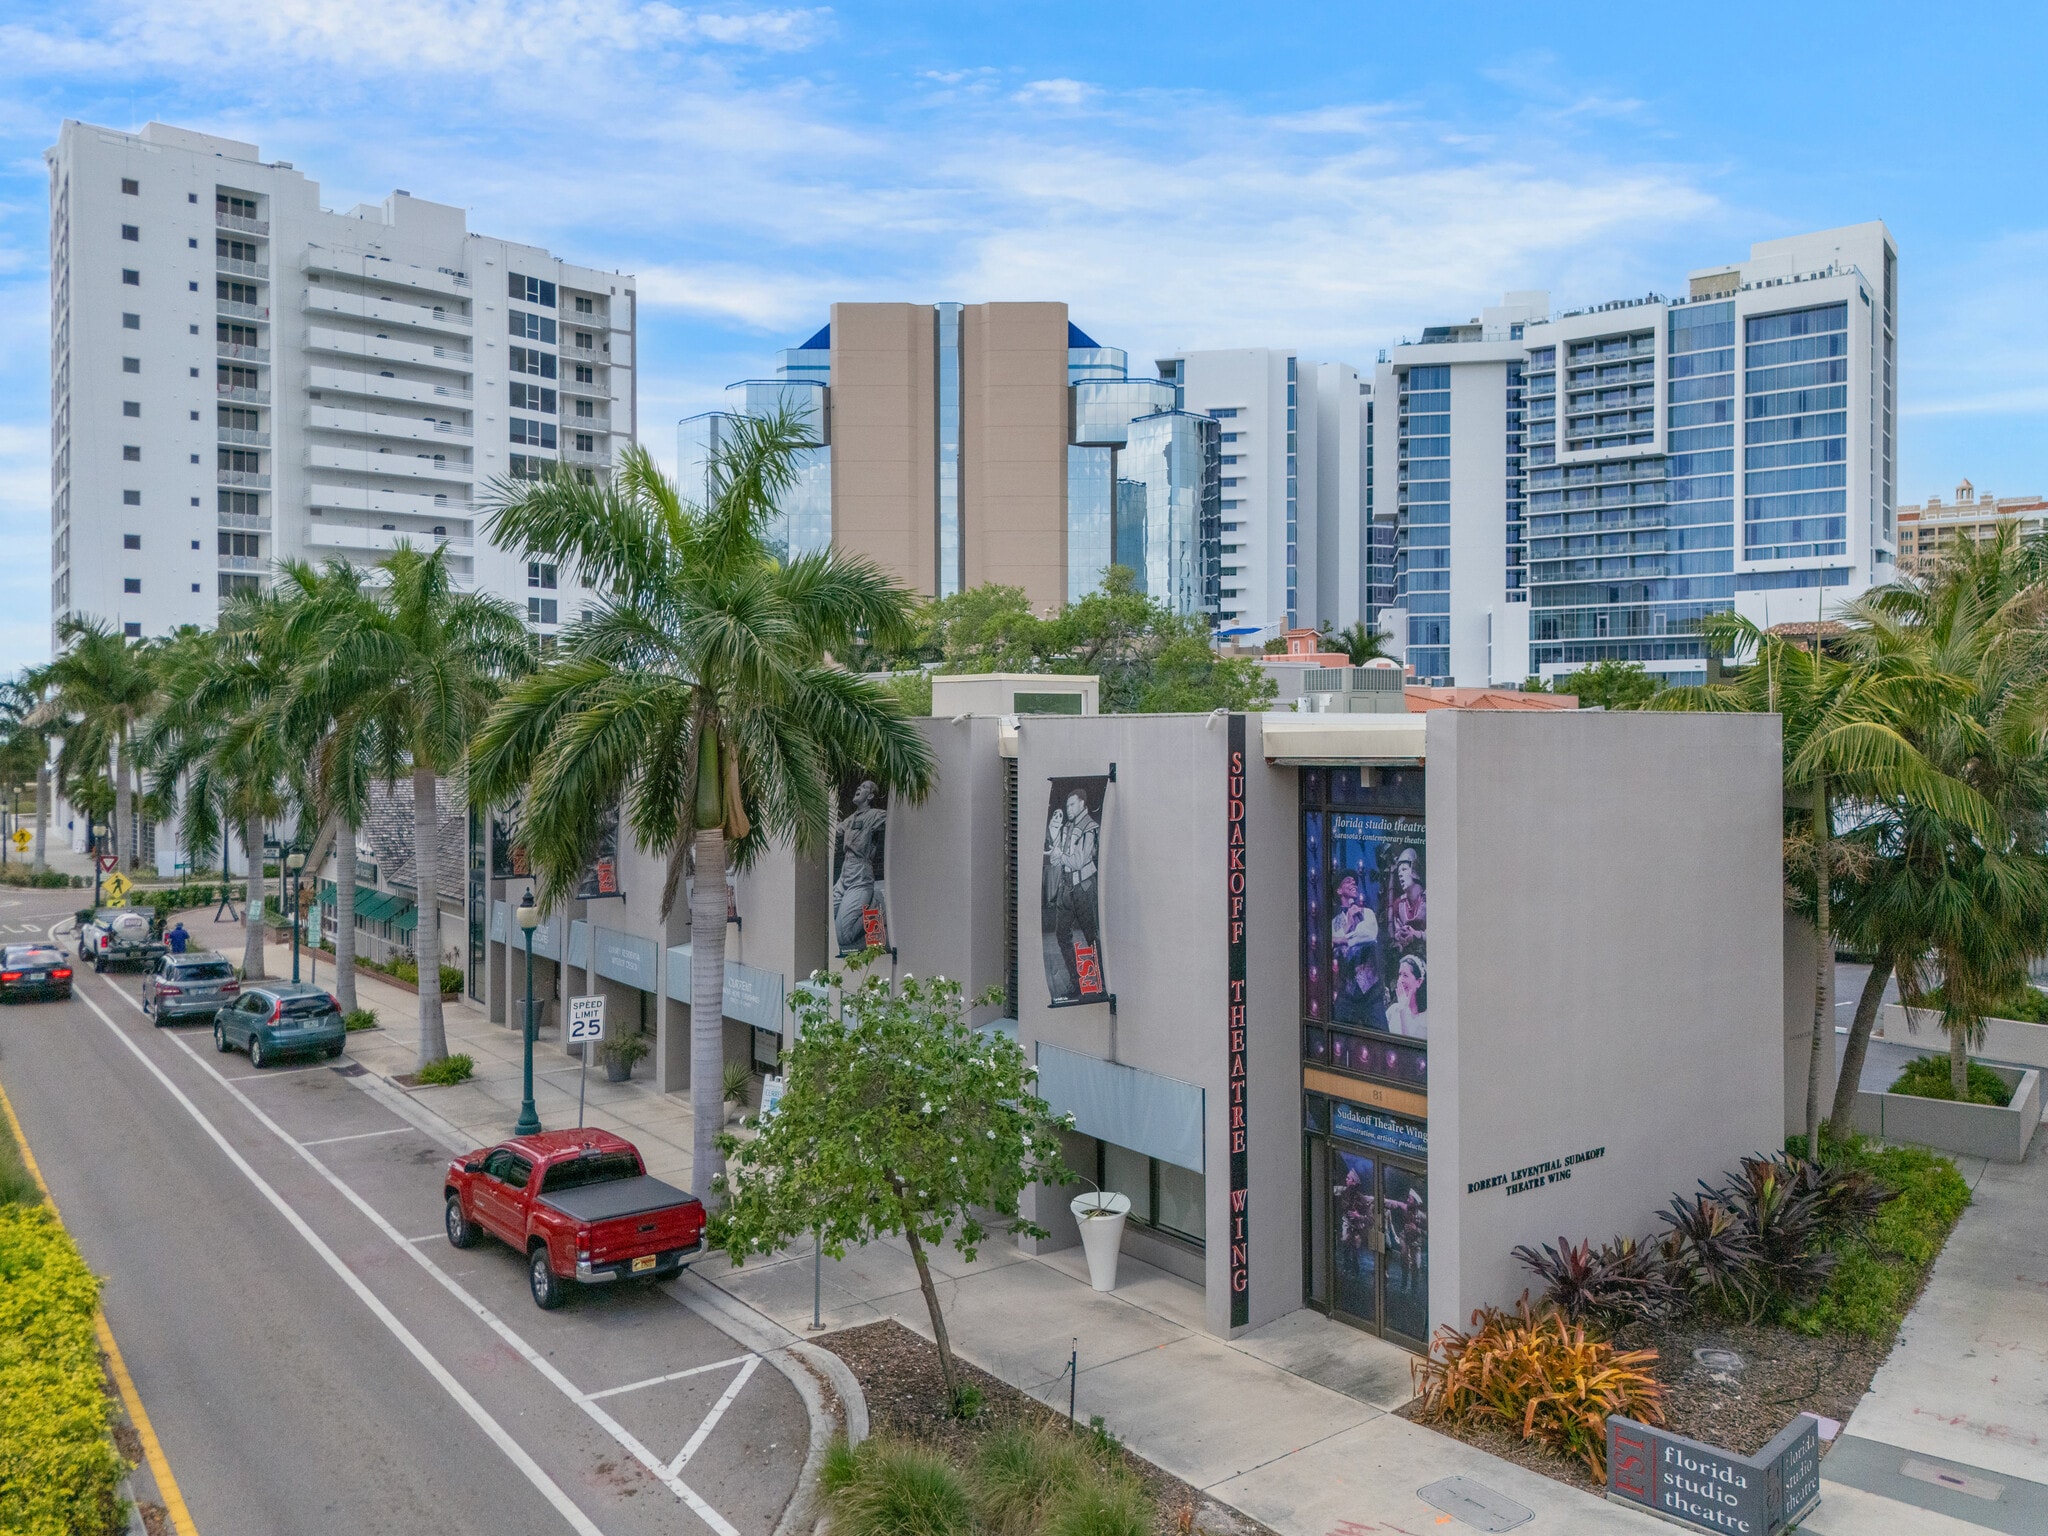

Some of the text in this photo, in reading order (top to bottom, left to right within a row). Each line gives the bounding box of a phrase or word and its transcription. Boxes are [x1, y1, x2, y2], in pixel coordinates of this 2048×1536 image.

[1334, 816, 1426, 832] florida studio theatre
[1362, 834, 1403, 845] contemporary
[1404, 835, 1426, 845] theatre
[862, 904, 881, 946] FST
[1074, 941, 1098, 995] FST
[573, 1001, 602, 1010] SPEED
[575, 1010, 599, 1019] LIMIT
[572, 1019, 601, 1037] 25
[1229, 752, 1248, 1292] SUDAKOFF THEATRE WING
[1372, 1089, 1382, 1101] 81
[1337, 1107, 1372, 1125] Sudakoff
[1373, 1116, 1404, 1134] Theatre
[1467, 1147, 1605, 1193] ROBERTA LEVENTHAL SUDAKOFF
[1506, 1169, 1571, 1196] THEATRE WING
[1614, 1426, 1645, 1498] FST
[1664, 1446, 1748, 1489] florida
[1663, 1472, 1738, 1507] studio
[1664, 1491, 1750, 1533] theatre
